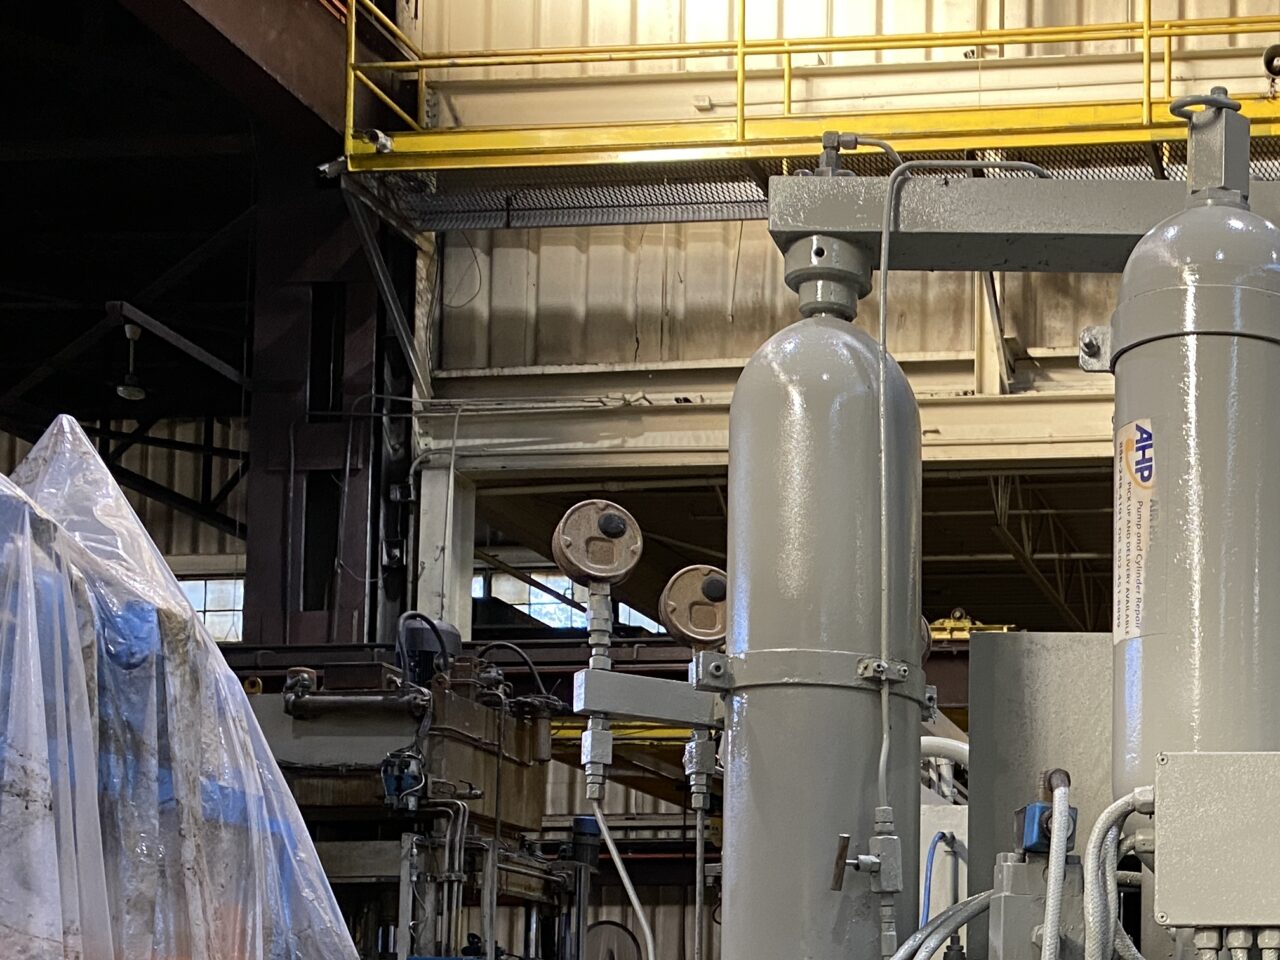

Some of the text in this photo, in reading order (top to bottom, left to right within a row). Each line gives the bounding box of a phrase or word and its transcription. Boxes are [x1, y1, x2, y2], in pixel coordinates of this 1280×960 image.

[1135, 423, 1153, 483] AHP
[1126, 504, 1132, 517] UP
[1134, 500, 1144, 628] Pump and Cylinder Repair
